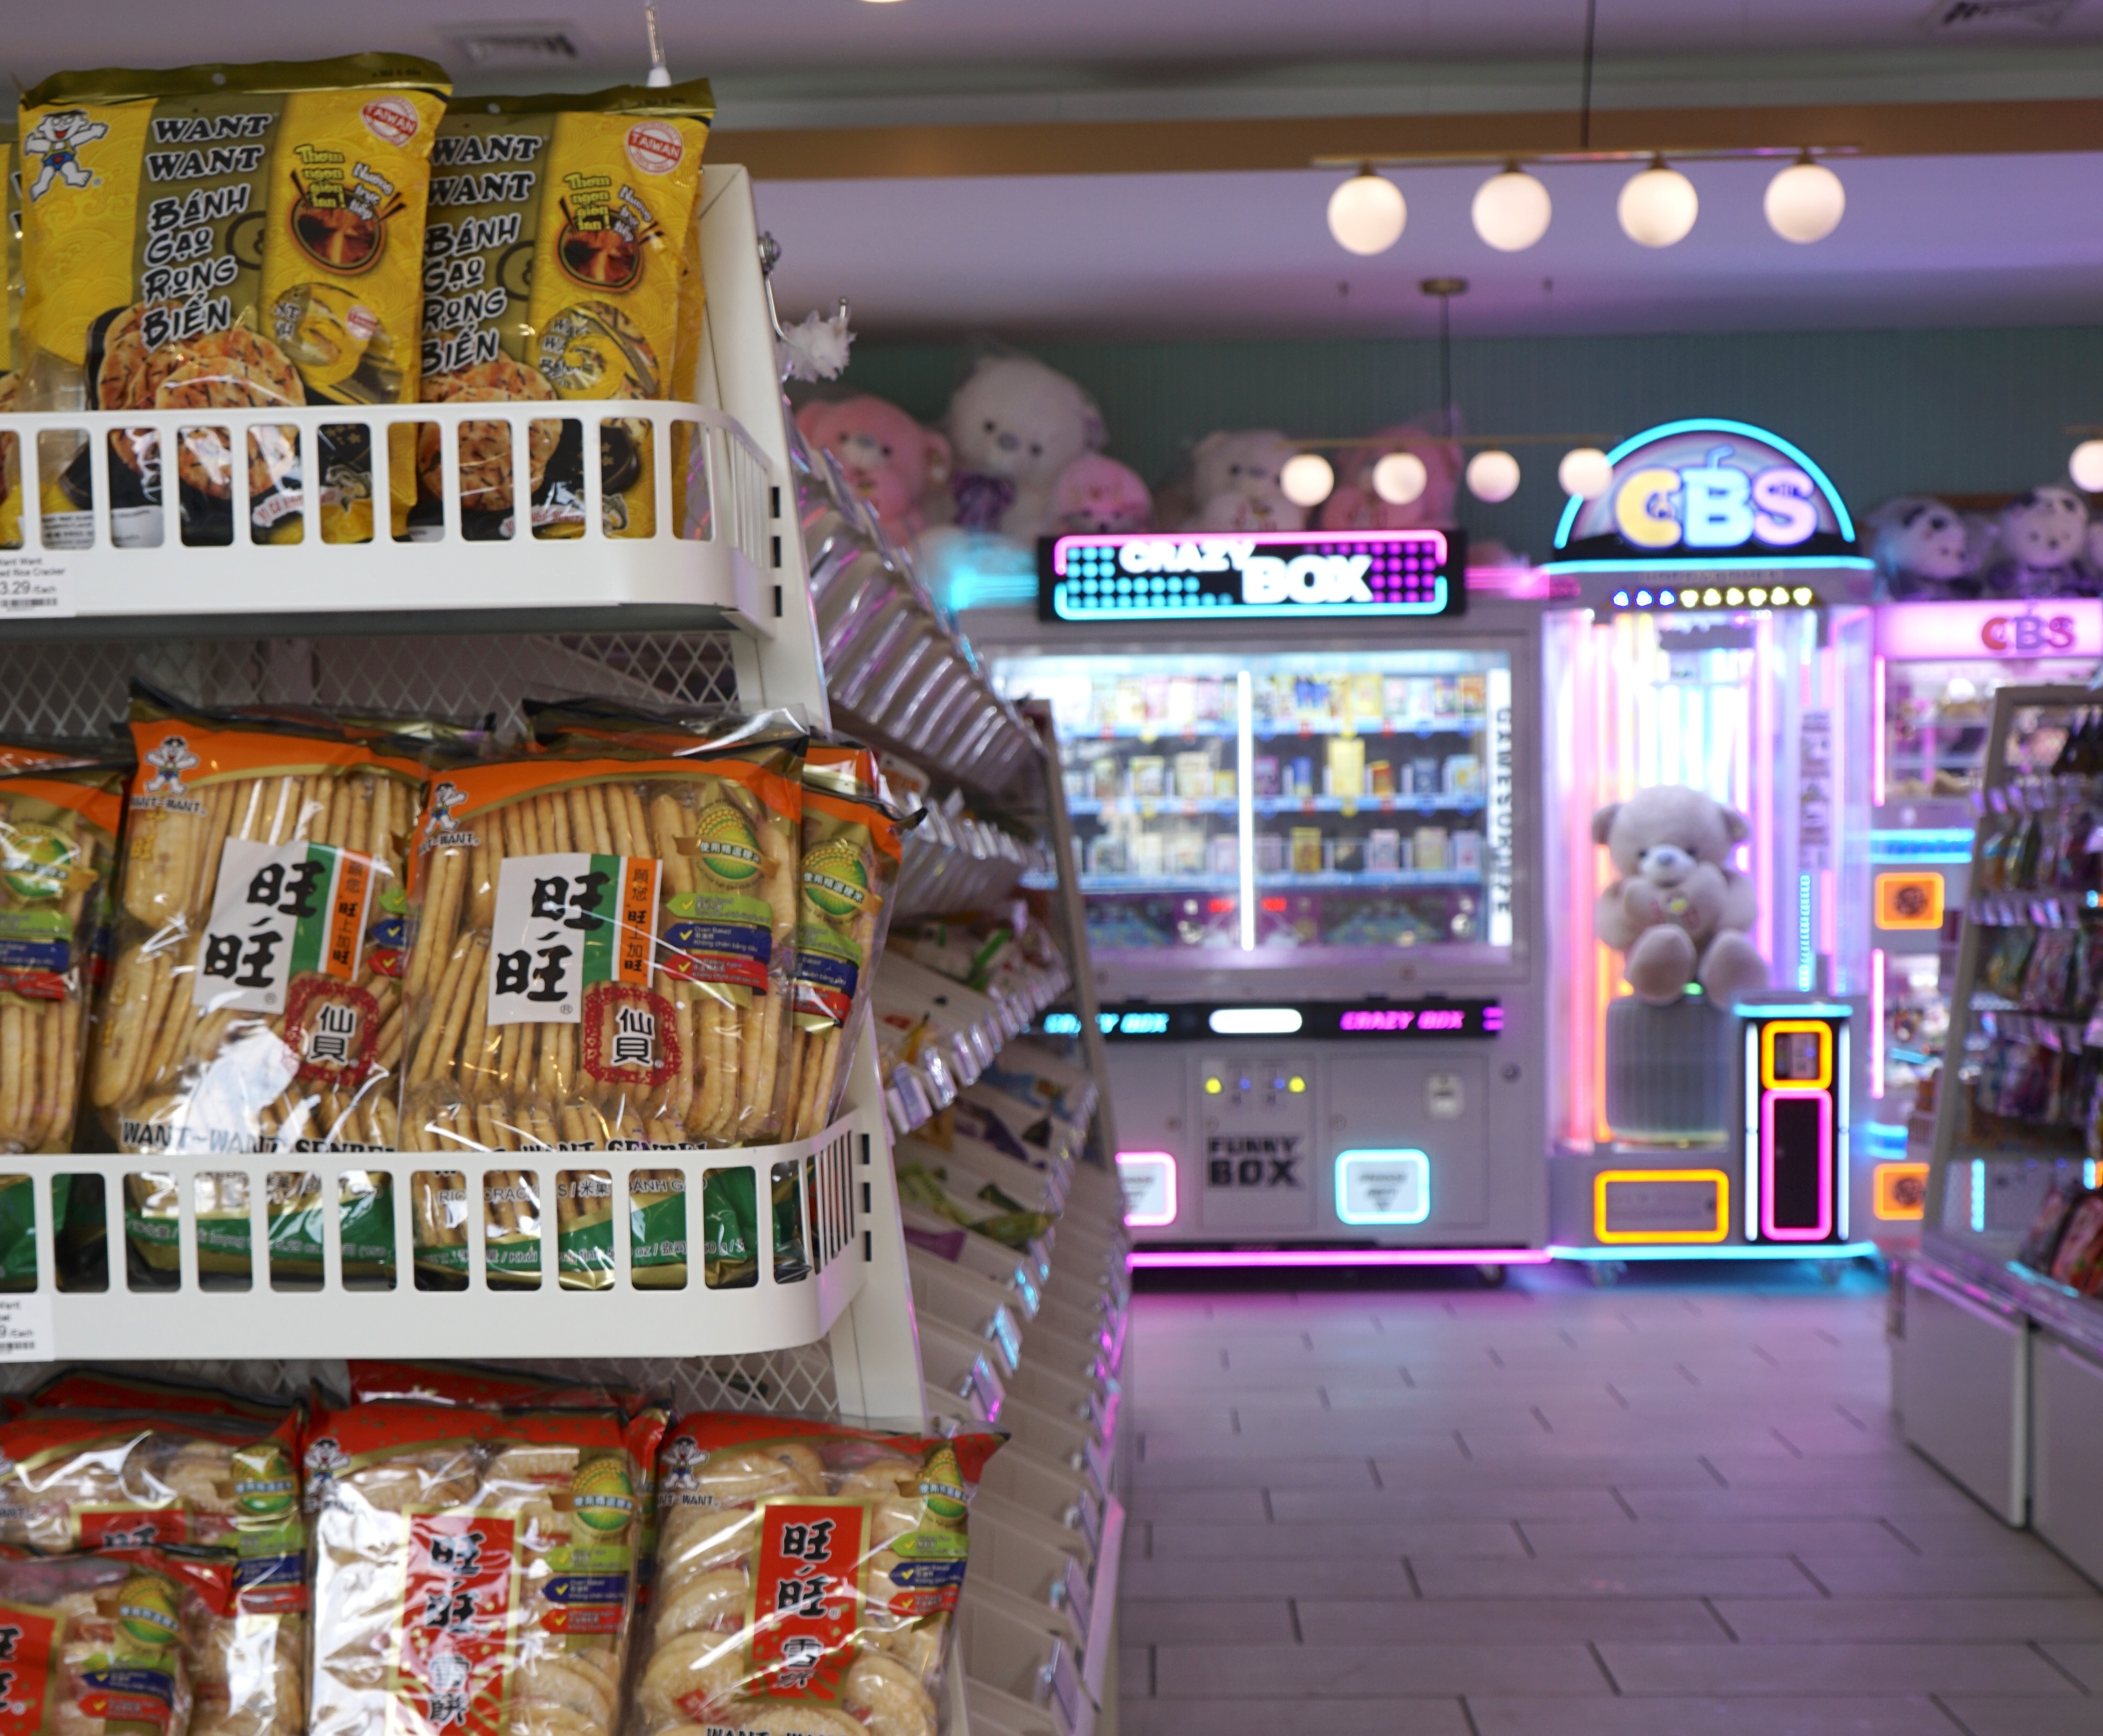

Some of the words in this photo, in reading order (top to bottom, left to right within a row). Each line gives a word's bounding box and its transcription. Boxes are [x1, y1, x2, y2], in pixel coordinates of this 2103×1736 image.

[154, 113, 272, 143] WANT
[364, 105, 418, 137] TAIWAN
[143, 145, 265, 182] WANT
[432, 135, 541, 166] WANT
[629, 131, 682, 160] TAIWAN
[428, 172, 535, 207] WANT
[147, 182, 251, 235] BÁNH
[143, 227, 214, 267] GẠO
[424, 213, 521, 259] BÁNH
[141, 256, 239, 307] RONG
[423, 257, 485, 294] GẠO
[141, 292, 231, 354] BIỂN
[423, 287, 508, 334] RONG
[421, 324, 500, 376] BIỂN
[1614, 467, 1819, 548] CBS
[1119, 539, 1256, 572] CRAZY
[1240, 554, 1374, 604] BOX
[1981, 616, 2074, 651] CBS
[204, 860, 326, 989] 旺旺
[495, 871, 610, 1003] 旺旺
[1340, 1010, 1415, 1030] CRAZY
[1417, 1010, 1465, 1030] BOX
[579, 1179, 610, 1195] 米果
[1209, 1159, 1305, 1189] BOX
[439, 1189, 466, 1203] RIC
[483, 1185, 567, 1203] CRACKS
[636, 1246, 652, 1258] oz
[658, 1494, 714, 1506] NT-WANT
[425, 1532, 486, 1633] 旺旺
[777, 1520, 836, 1619] 旺旺
